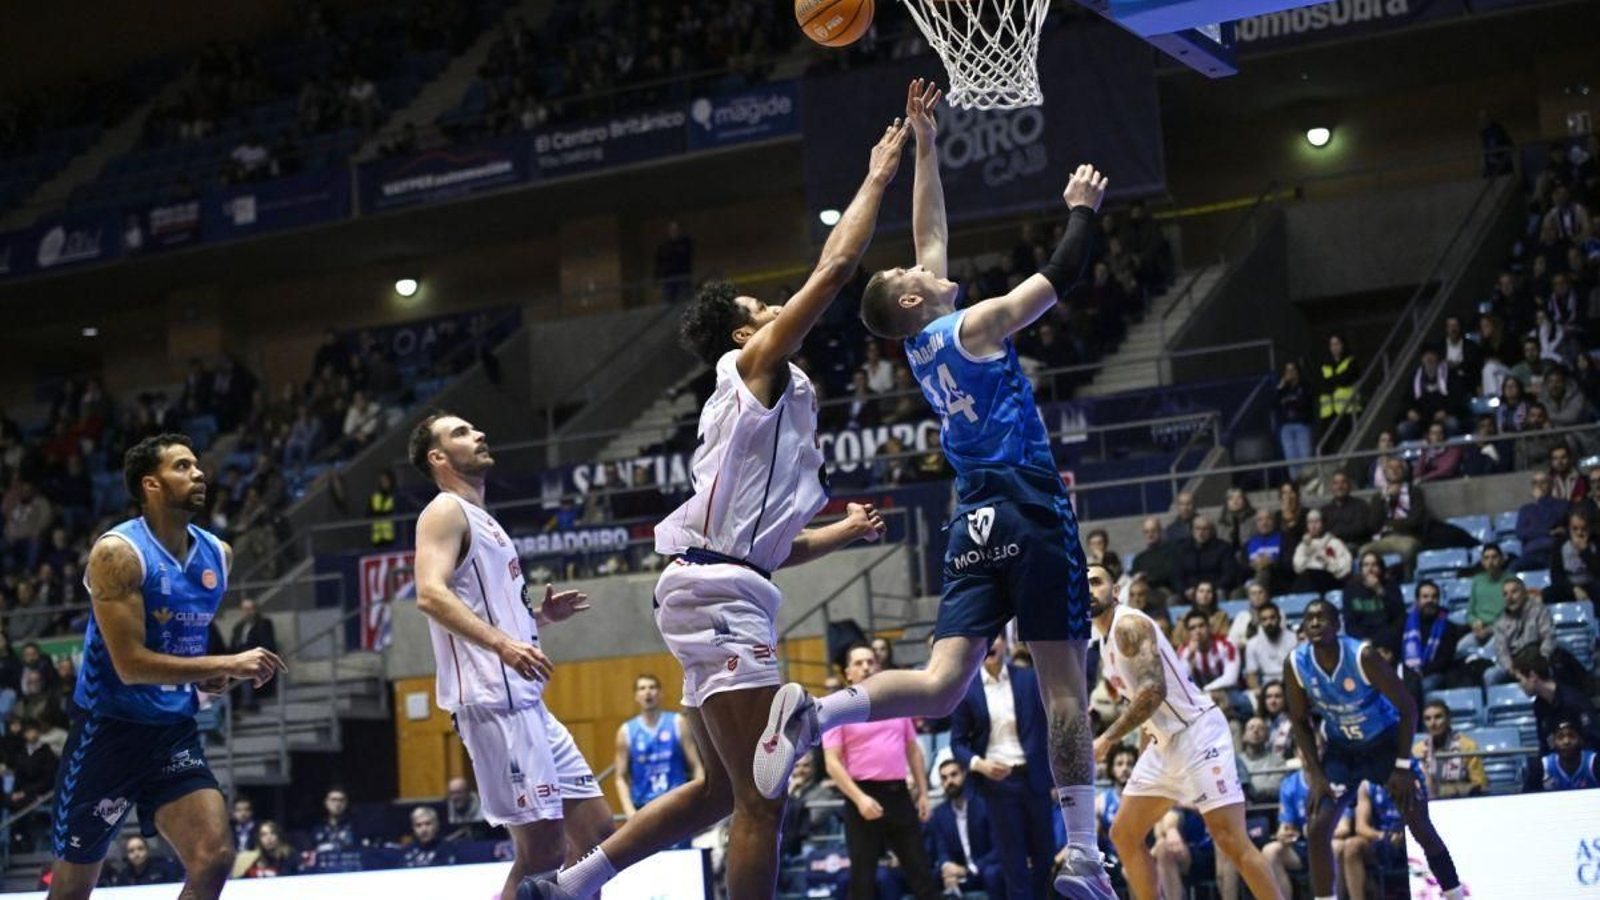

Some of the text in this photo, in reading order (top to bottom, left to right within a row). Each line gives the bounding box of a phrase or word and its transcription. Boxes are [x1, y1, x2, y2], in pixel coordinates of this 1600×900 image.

[1235, 0, 1409, 43] omosObra
[534, 135, 551, 154] El
[551, 124, 608, 151] Centro
